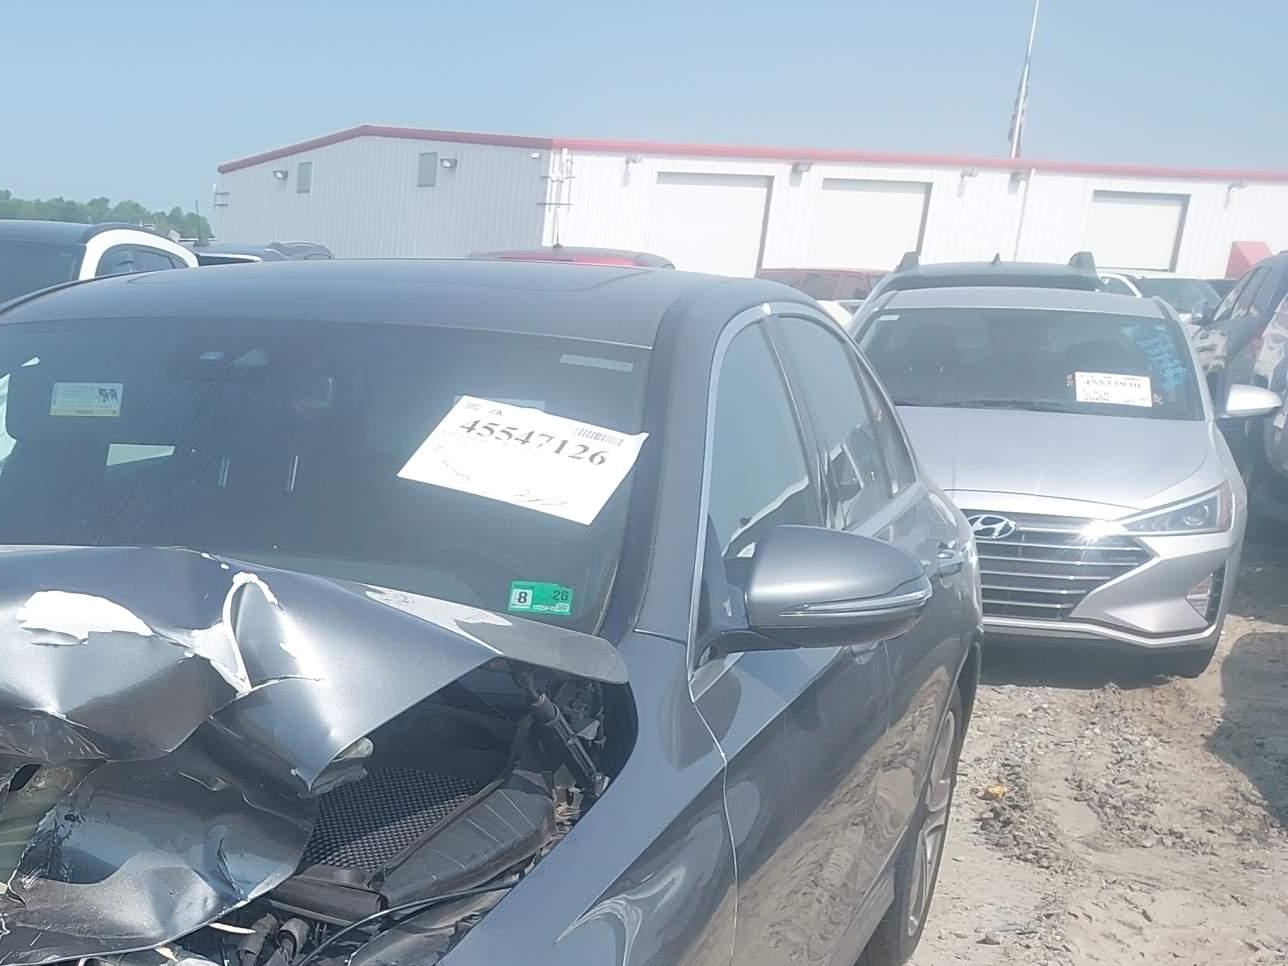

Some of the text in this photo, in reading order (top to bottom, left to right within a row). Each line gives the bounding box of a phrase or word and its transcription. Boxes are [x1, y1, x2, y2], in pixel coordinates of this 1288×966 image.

[460, 419, 608, 466] 45547126
[517, 591, 569, 604] 8 26
